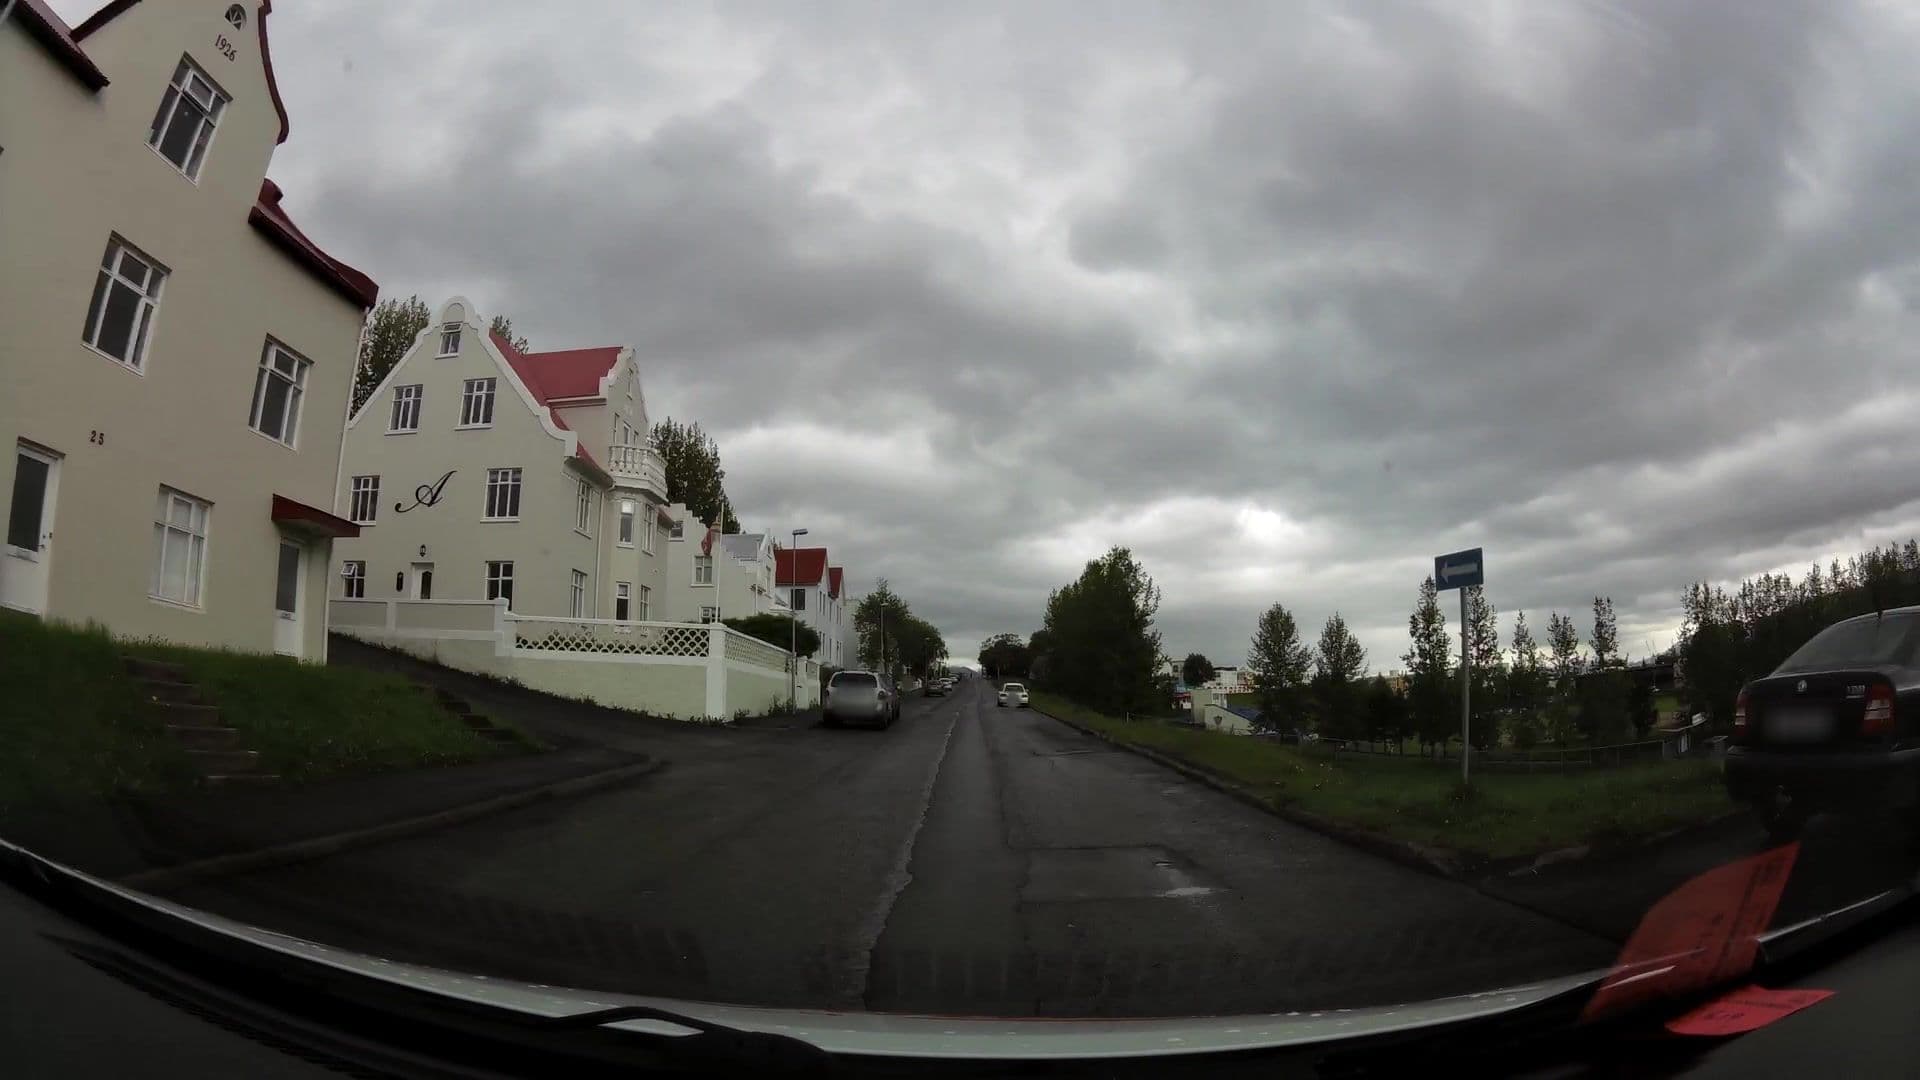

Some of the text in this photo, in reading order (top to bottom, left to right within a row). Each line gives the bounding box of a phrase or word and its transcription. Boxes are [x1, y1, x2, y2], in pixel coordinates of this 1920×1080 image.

[215, 34, 237, 62] 1926
[90, 430, 104, 445] 25
[395, 470, 458, 513] A
